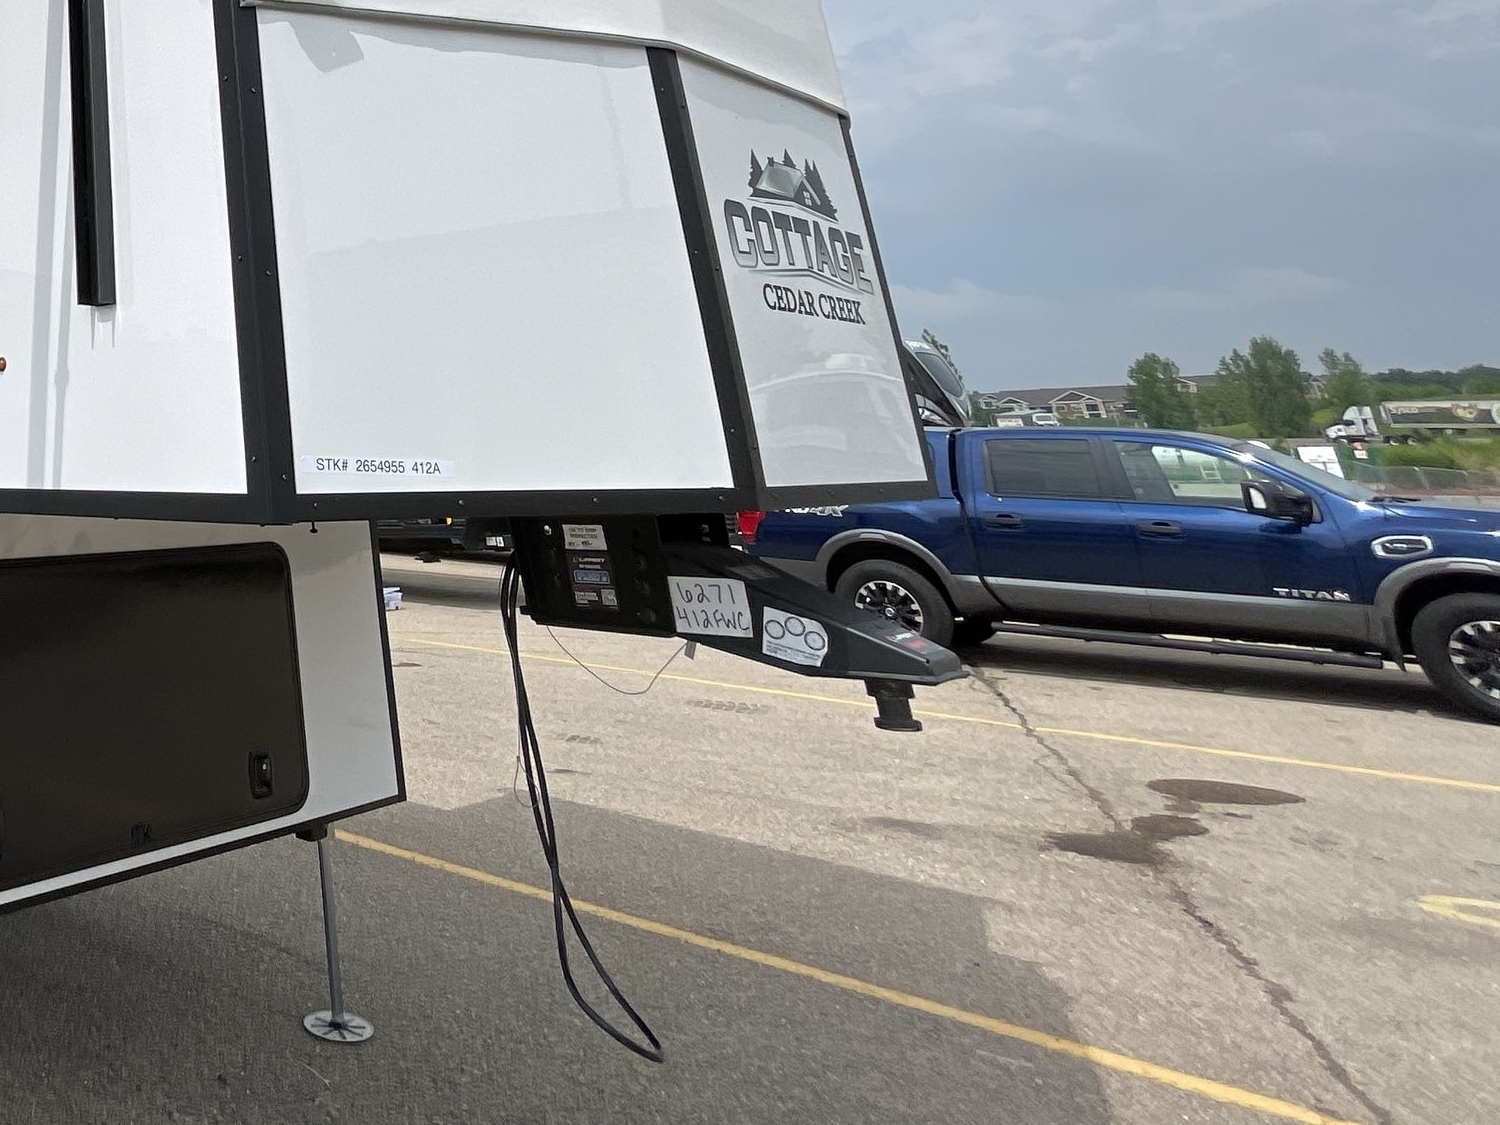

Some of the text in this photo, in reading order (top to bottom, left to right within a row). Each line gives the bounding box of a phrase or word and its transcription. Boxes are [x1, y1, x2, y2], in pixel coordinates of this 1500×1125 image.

[723, 198, 875, 295] COTTAGE
[762, 282, 866, 325] CEDAR CREEK
[316, 457, 441, 475] STK# 2654955 412A
[676, 582, 736, 604] 6271
[1273, 587, 1351, 602] TITAN
[676, 606, 750, 631] 412FWC
